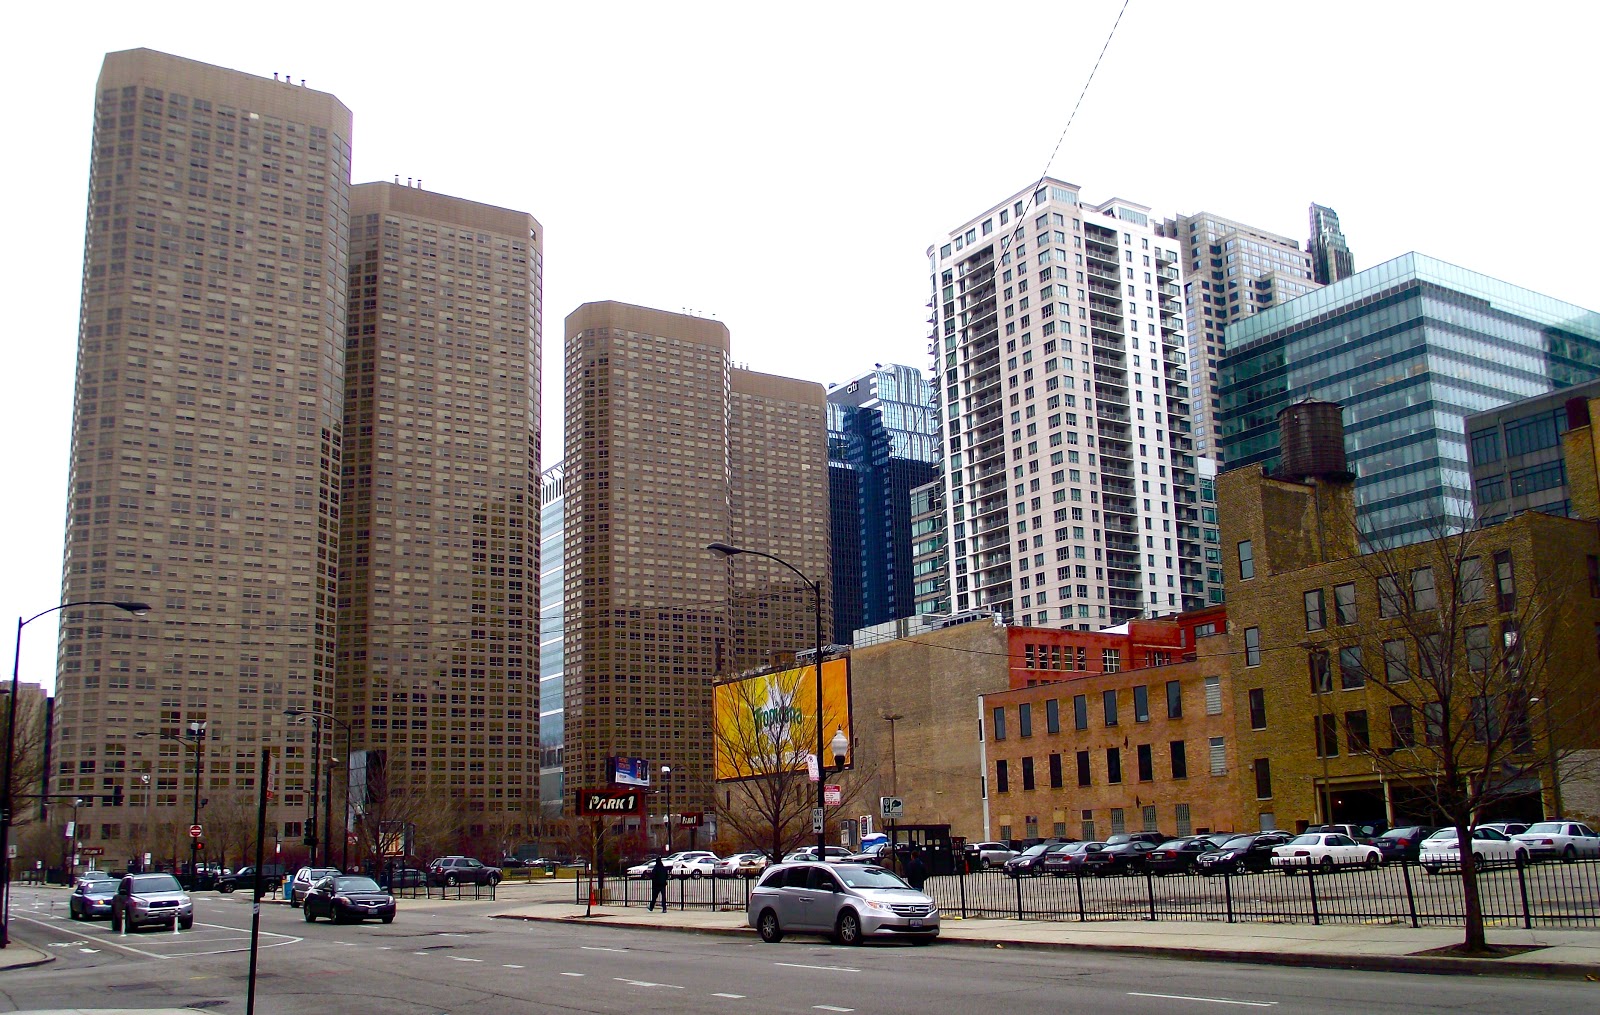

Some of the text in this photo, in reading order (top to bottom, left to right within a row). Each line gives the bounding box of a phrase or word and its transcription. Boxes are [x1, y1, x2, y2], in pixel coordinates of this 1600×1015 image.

[846, 381, 858, 394] citi
[588, 795, 634, 810] PARK 1
